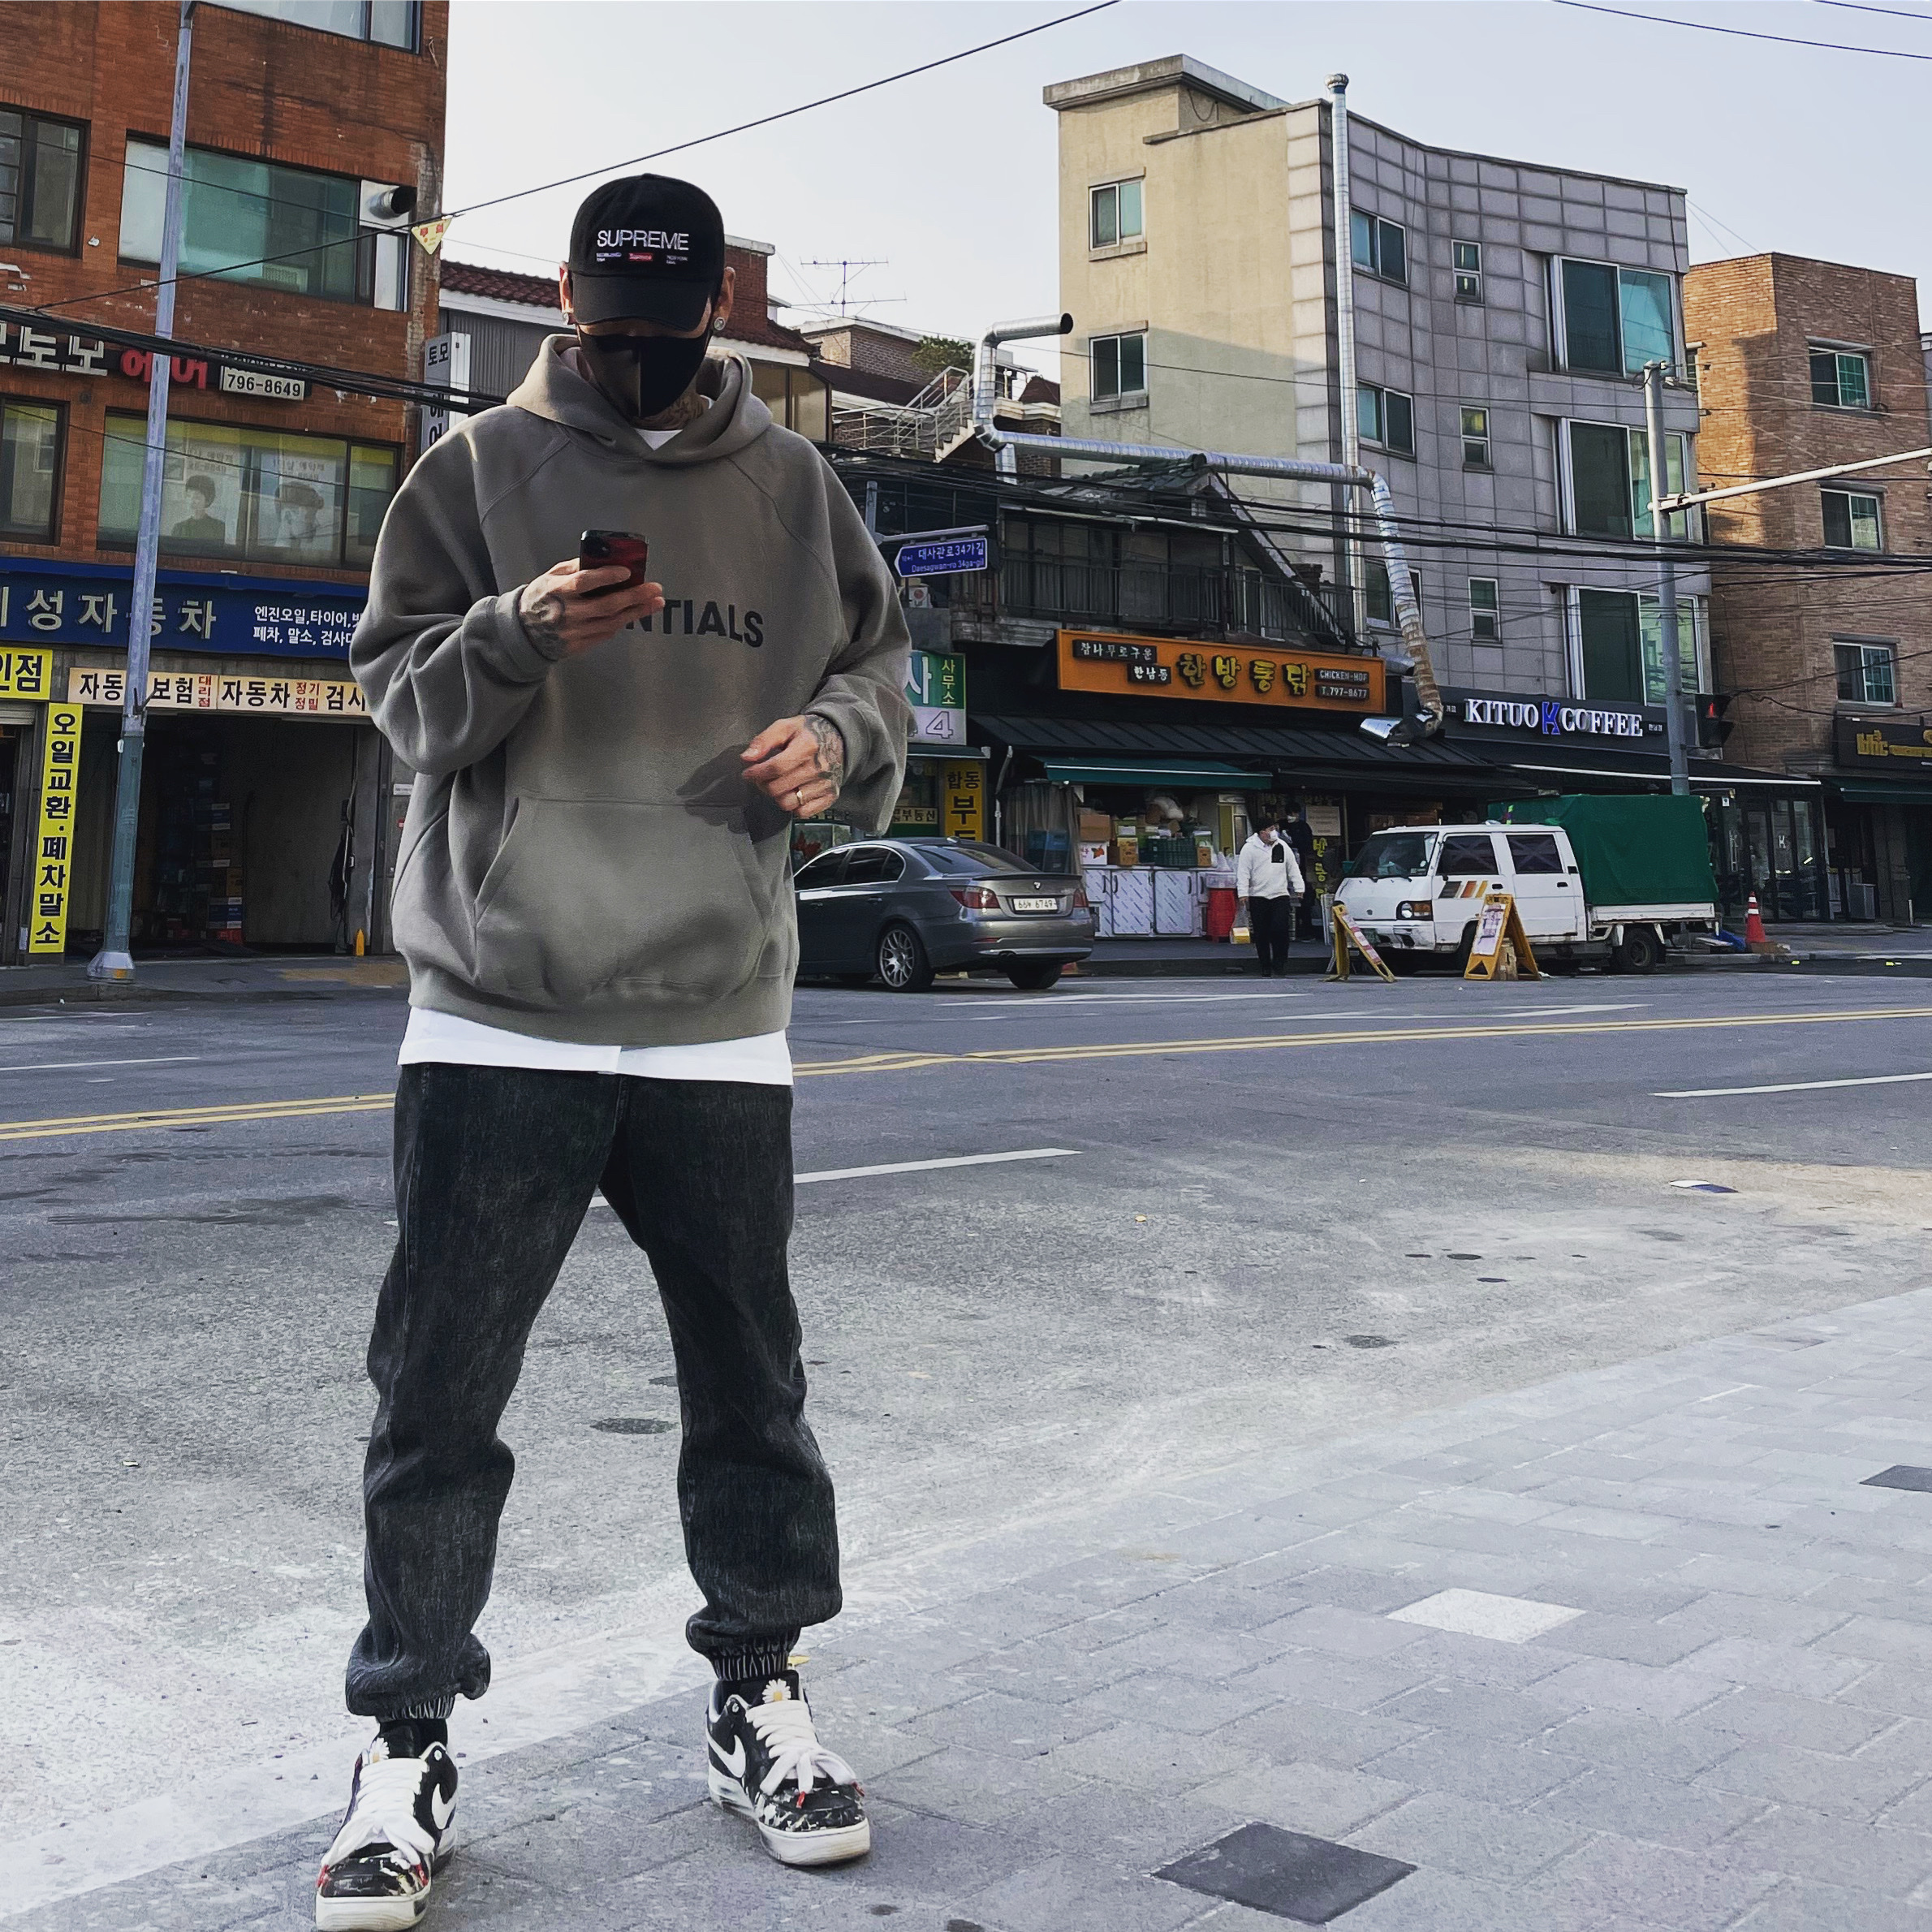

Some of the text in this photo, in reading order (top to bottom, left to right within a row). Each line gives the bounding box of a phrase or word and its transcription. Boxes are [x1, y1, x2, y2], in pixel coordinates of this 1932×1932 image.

[597, 229, 689, 251] SUPREME
[428, 342, 449, 366] 토모
[226, 373, 301, 397] 796-8649
[287, 627, 317, 645] 말소,
[942, 659, 955, 705] 사무소
[1133, 666, 1169, 681] 한남동
[1178, 652, 1311, 698] 한방통닭
[197, 675, 212, 708] 대리점
[222, 679, 290, 709] 자동차
[296, 682, 321, 696] 정기
[295, 697, 319, 711] 정밀
[1464, 698, 1643, 737] KITUO K COFFEE
[947, 771, 980, 790] 합동
